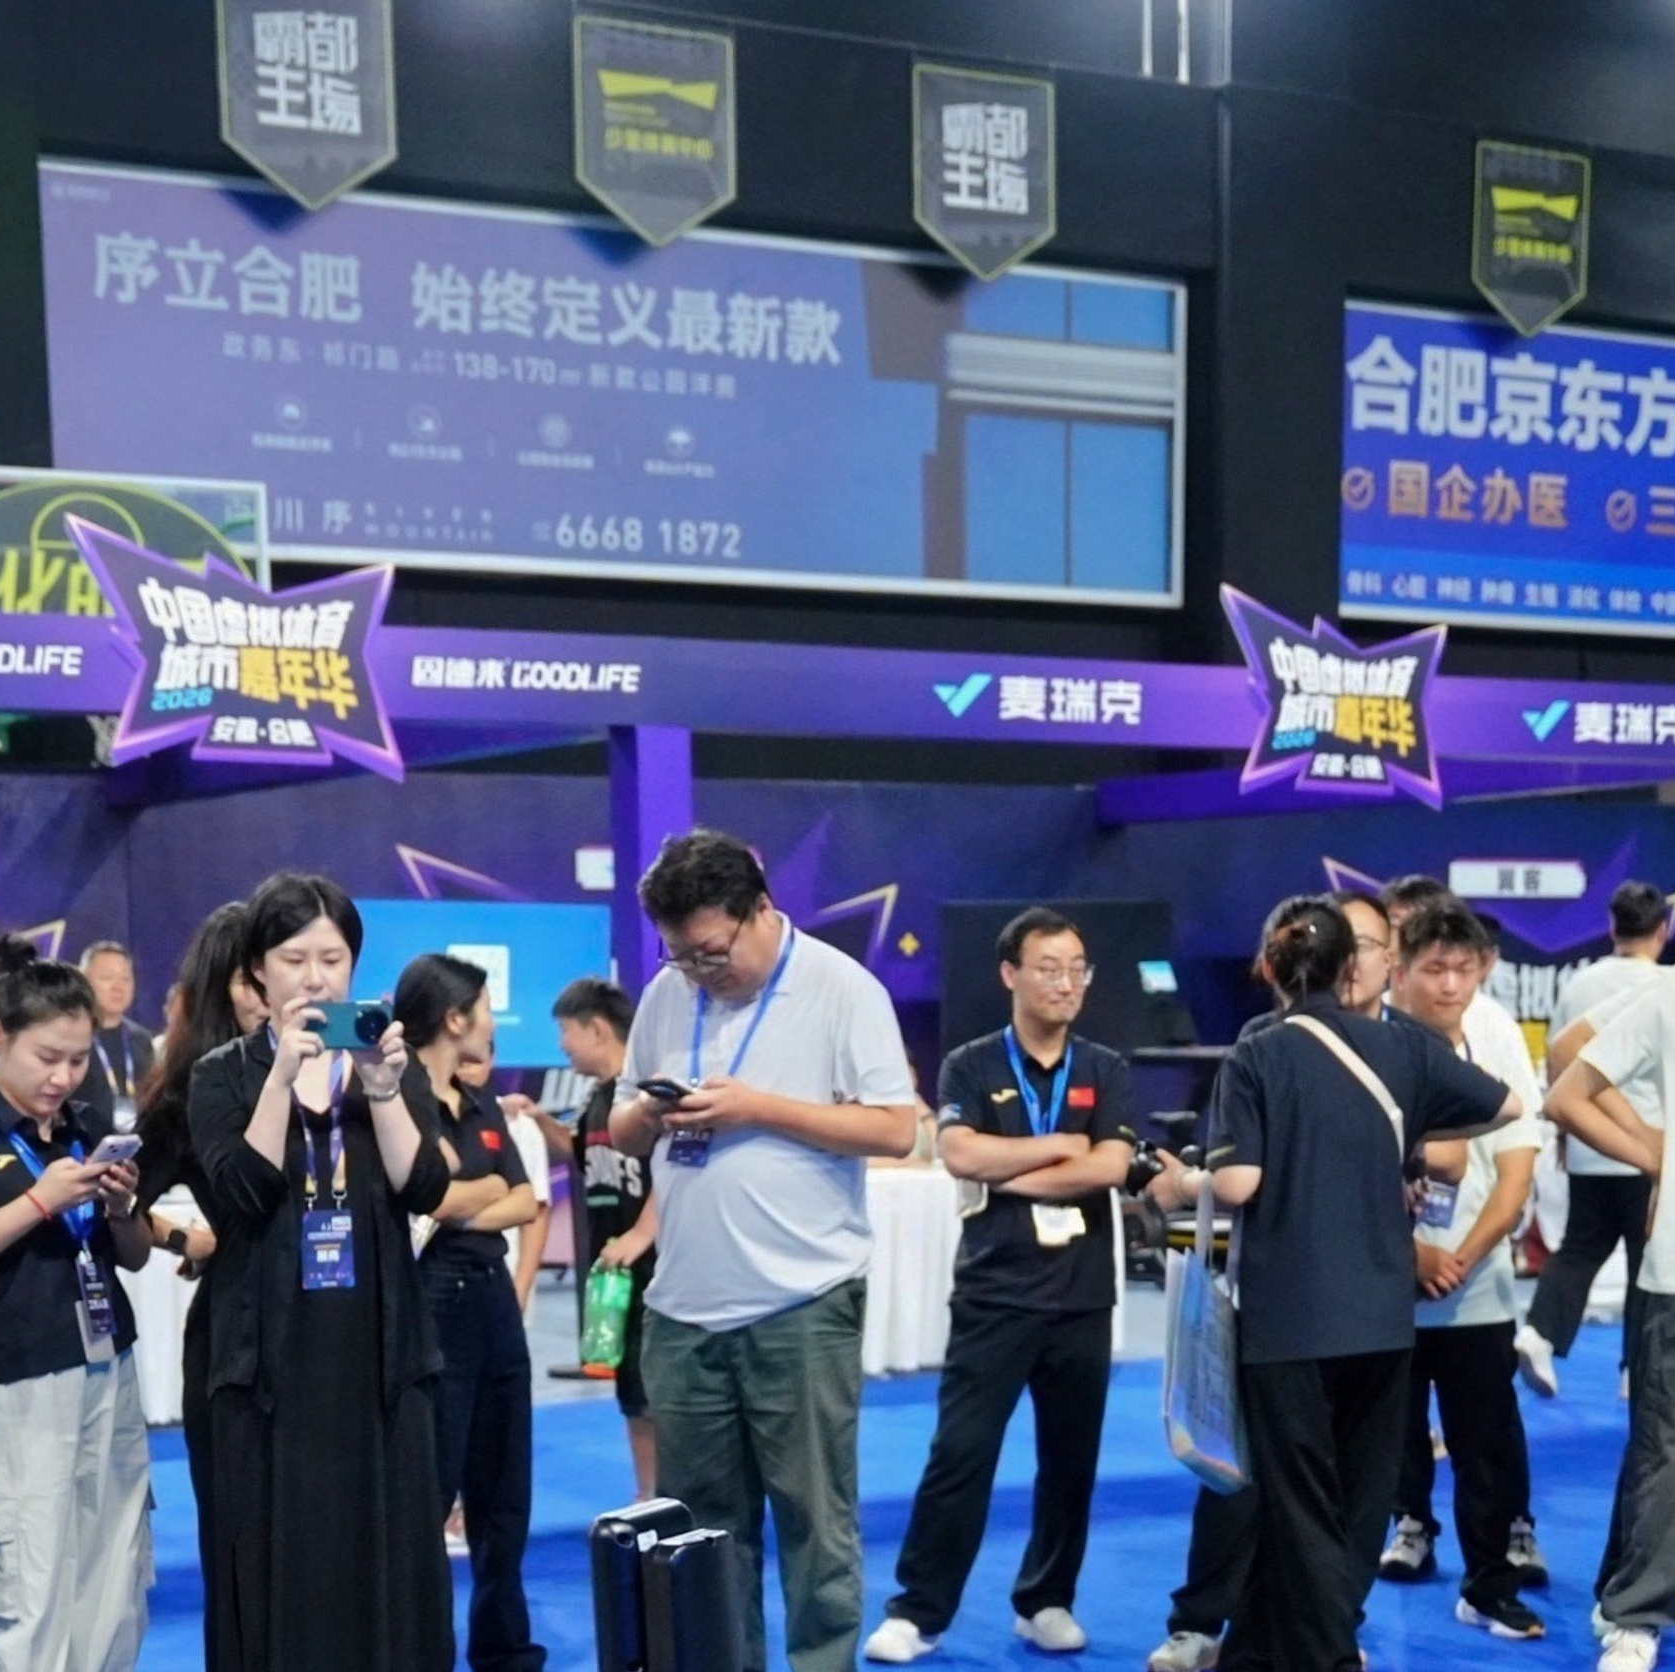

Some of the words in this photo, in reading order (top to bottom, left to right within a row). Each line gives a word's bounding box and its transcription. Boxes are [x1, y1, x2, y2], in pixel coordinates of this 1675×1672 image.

[93, 230, 363, 324] 序立合肥
[410, 260, 843, 367] 始终定义最新款
[1388, 459, 1569, 530] 国企办医
[555, 512, 644, 552] 6668
[657, 517, 742, 560] 1872
[510, 659, 642, 693] GOODLIFE
[998, 674, 1143, 726] 麦瑞克
